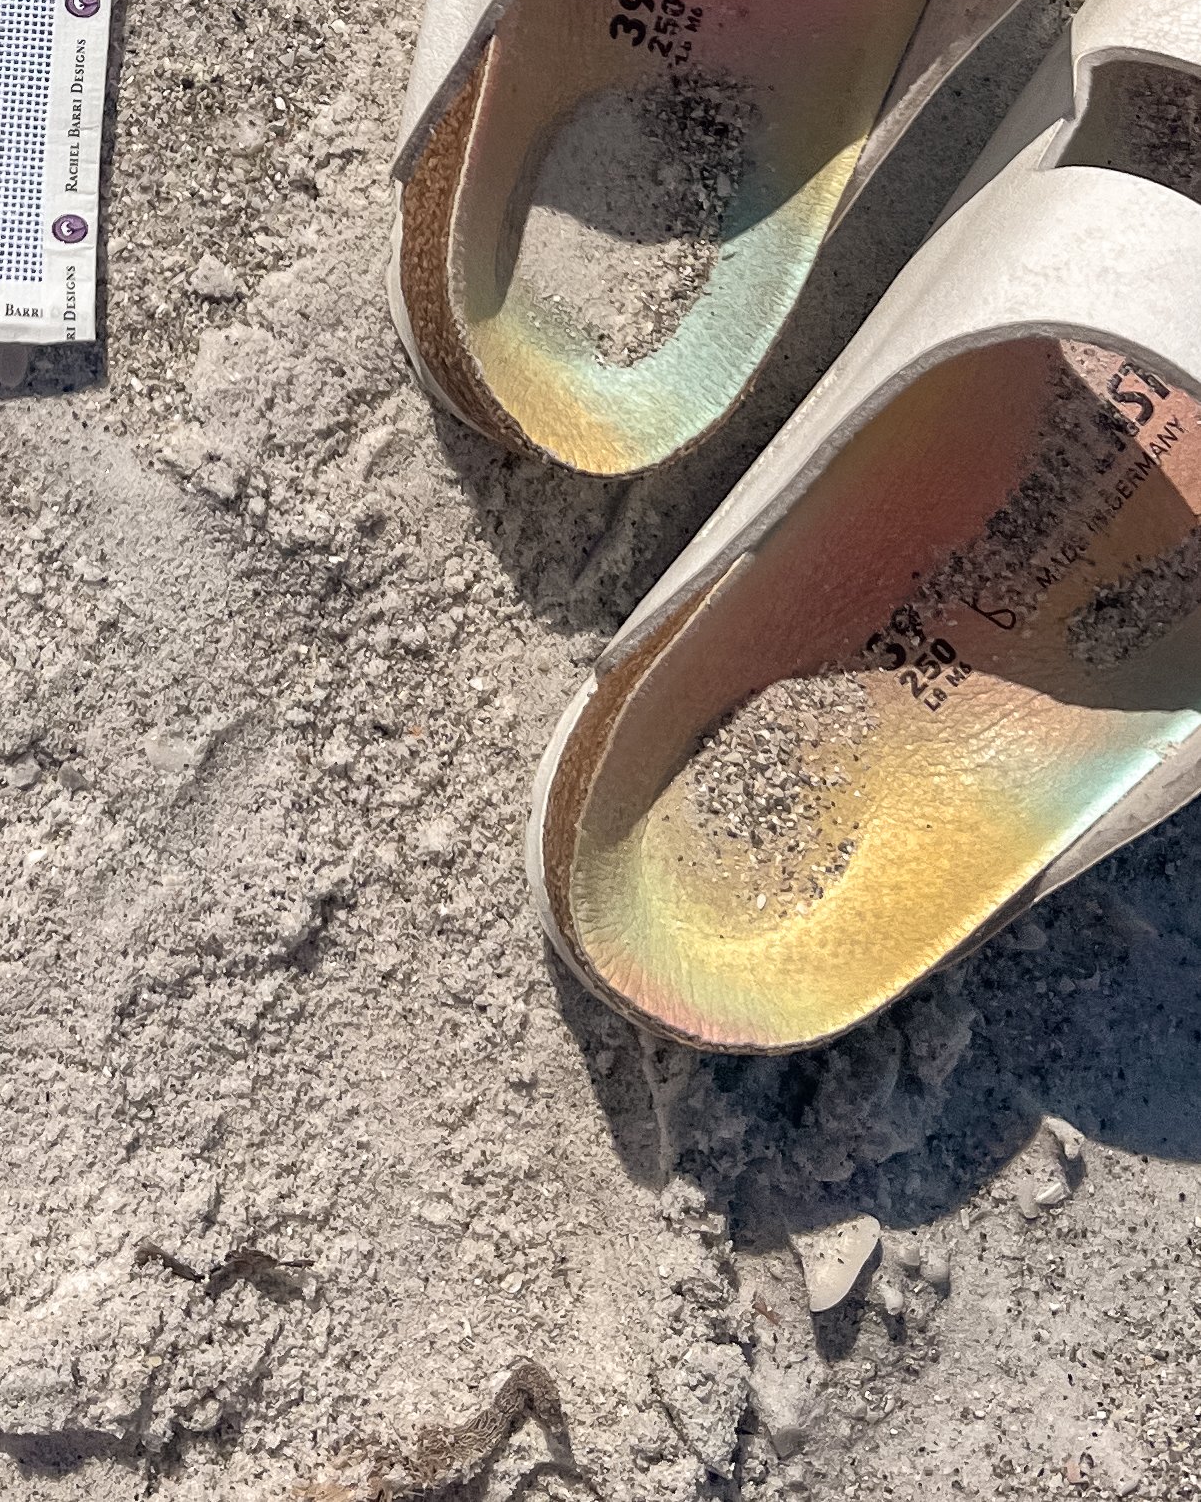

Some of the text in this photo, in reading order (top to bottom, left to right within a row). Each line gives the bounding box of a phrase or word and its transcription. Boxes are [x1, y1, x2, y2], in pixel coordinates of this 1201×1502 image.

[64, 39, 86, 193] RACHEL BARRI DESIGNS
[63, 265, 76, 322] DESIGNS
[1107, 414, 1186, 511] GERMANY
[899, 638, 957, 699] 250
